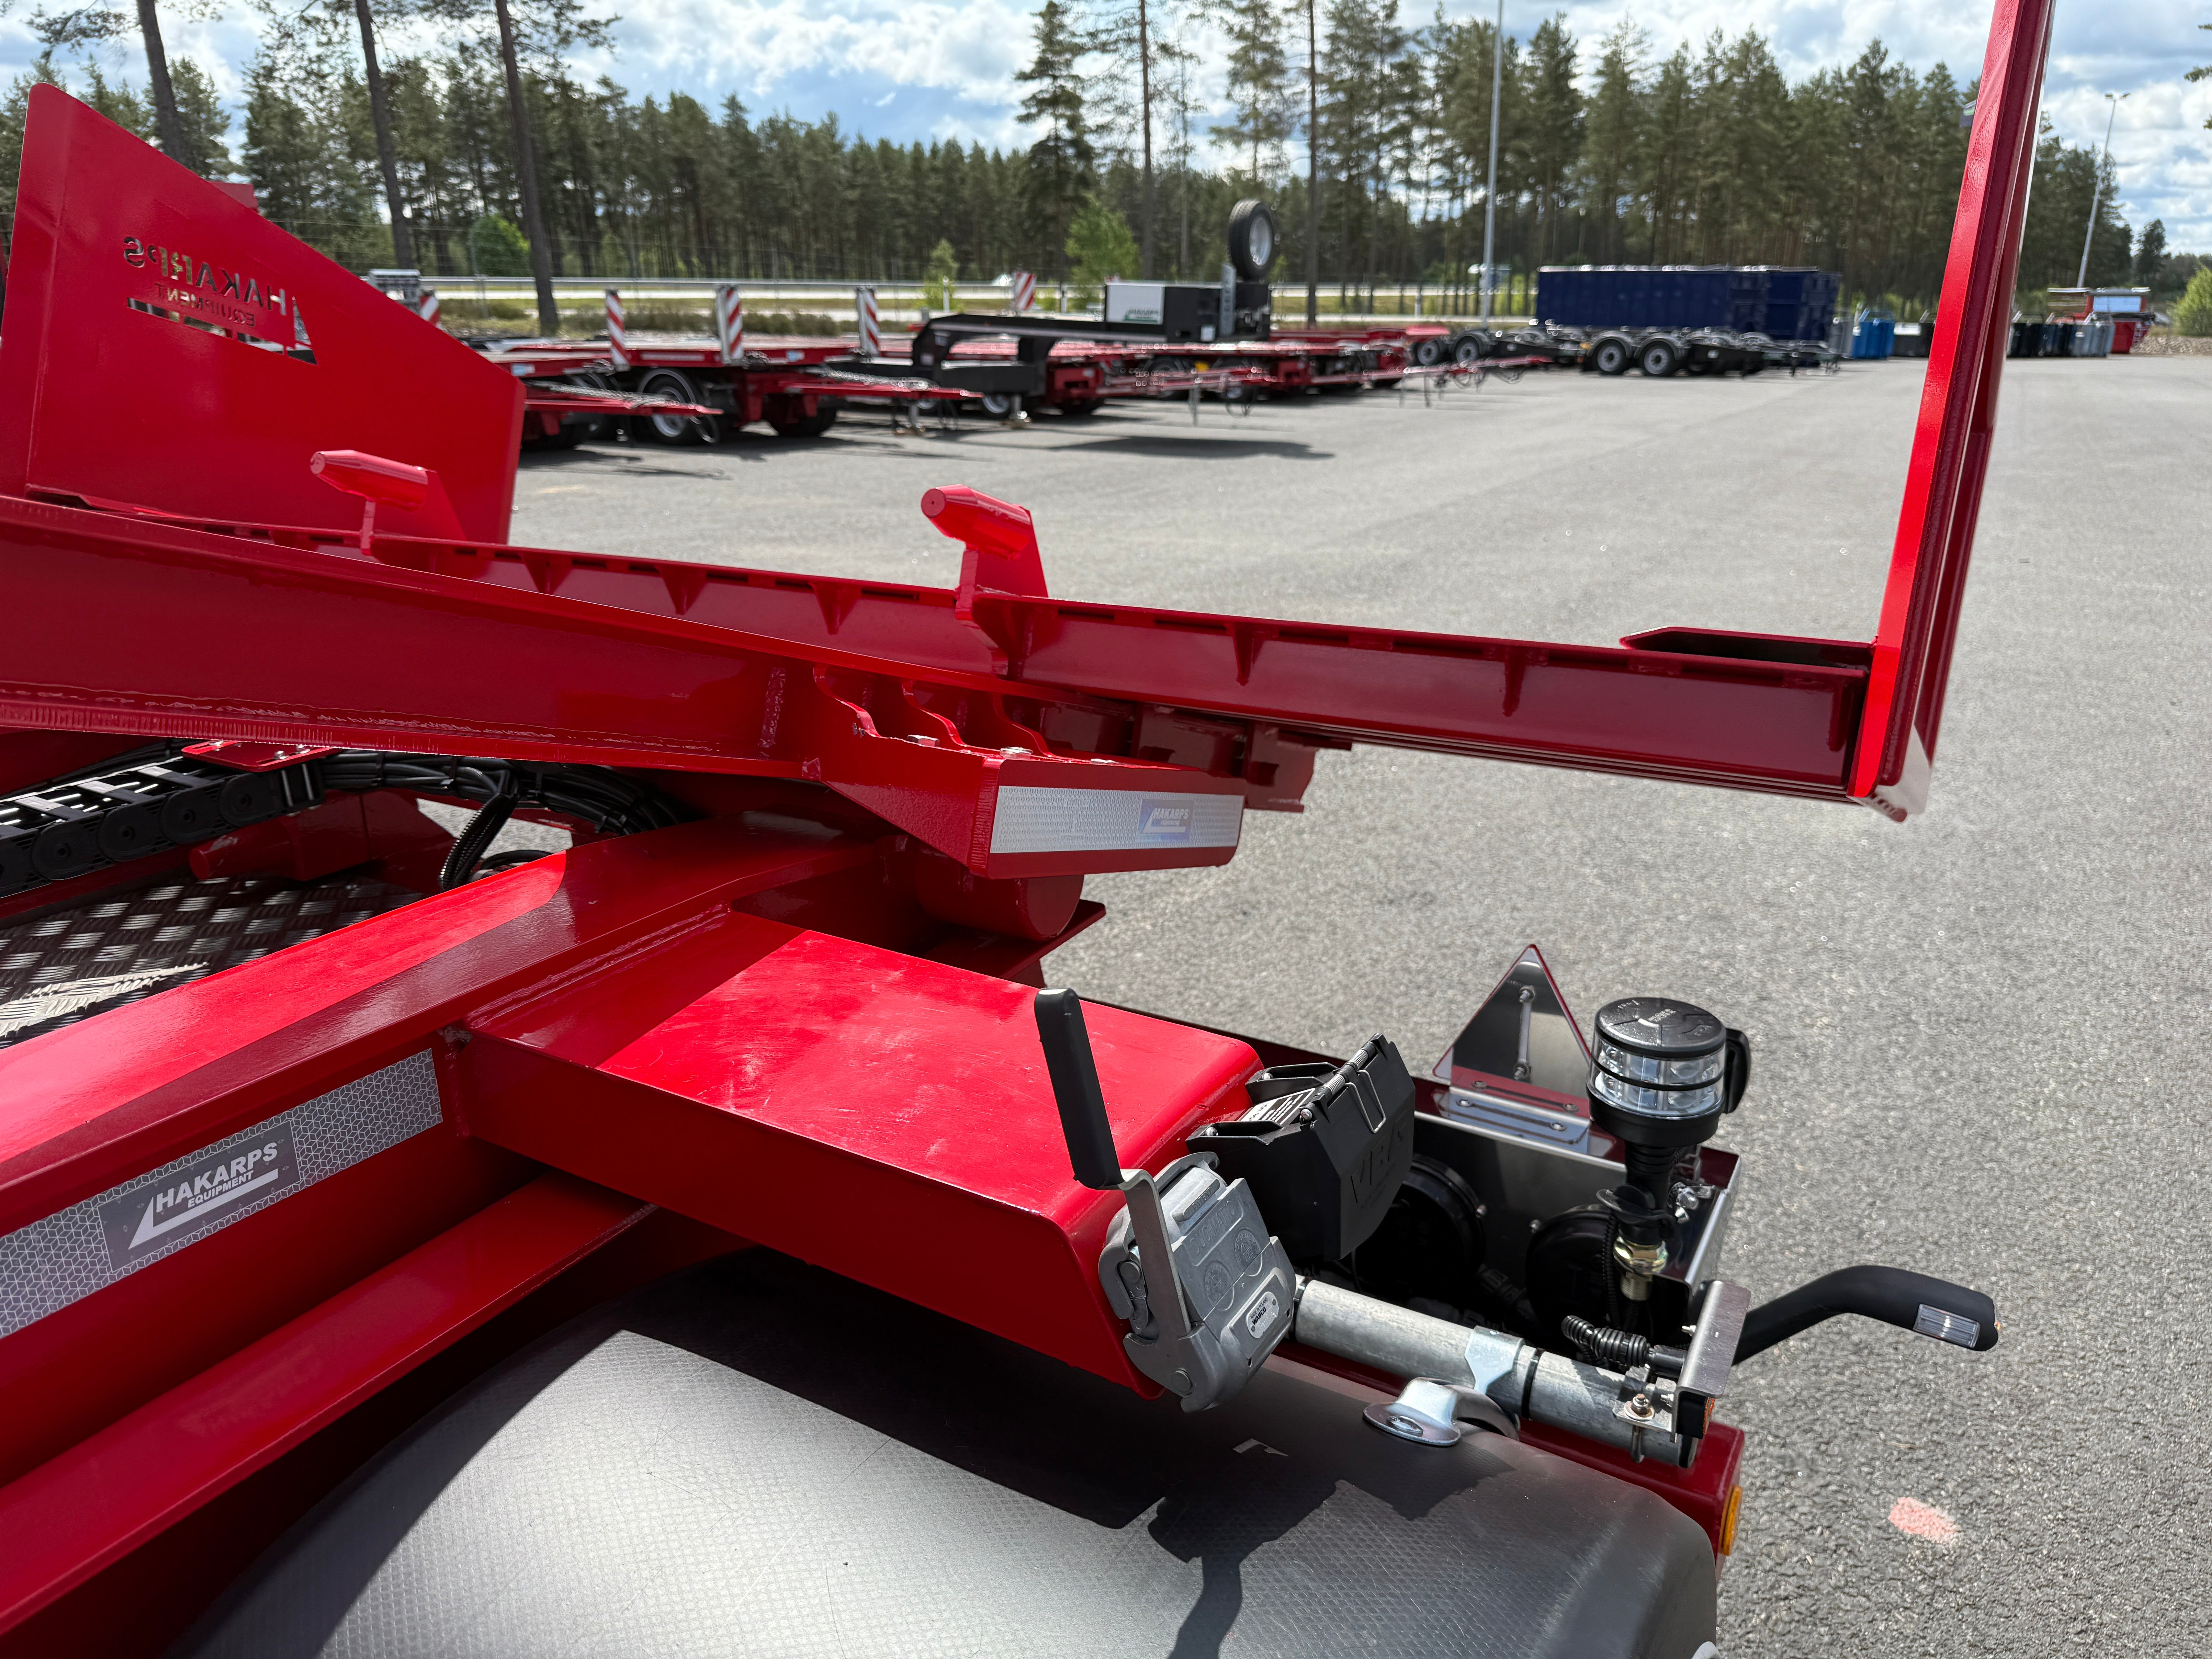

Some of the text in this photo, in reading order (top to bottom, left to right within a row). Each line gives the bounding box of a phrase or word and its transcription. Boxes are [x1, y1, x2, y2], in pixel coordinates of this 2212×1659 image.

[1153, 808, 1189, 819] HAKARPS
[156, 1142, 278, 1213] HAKARPS
[188, 1170, 254, 1208] EQUIPMENT
[1259, 1297, 1268, 1309] POLAND
[1252, 1307, 1266, 1325] WABCO
